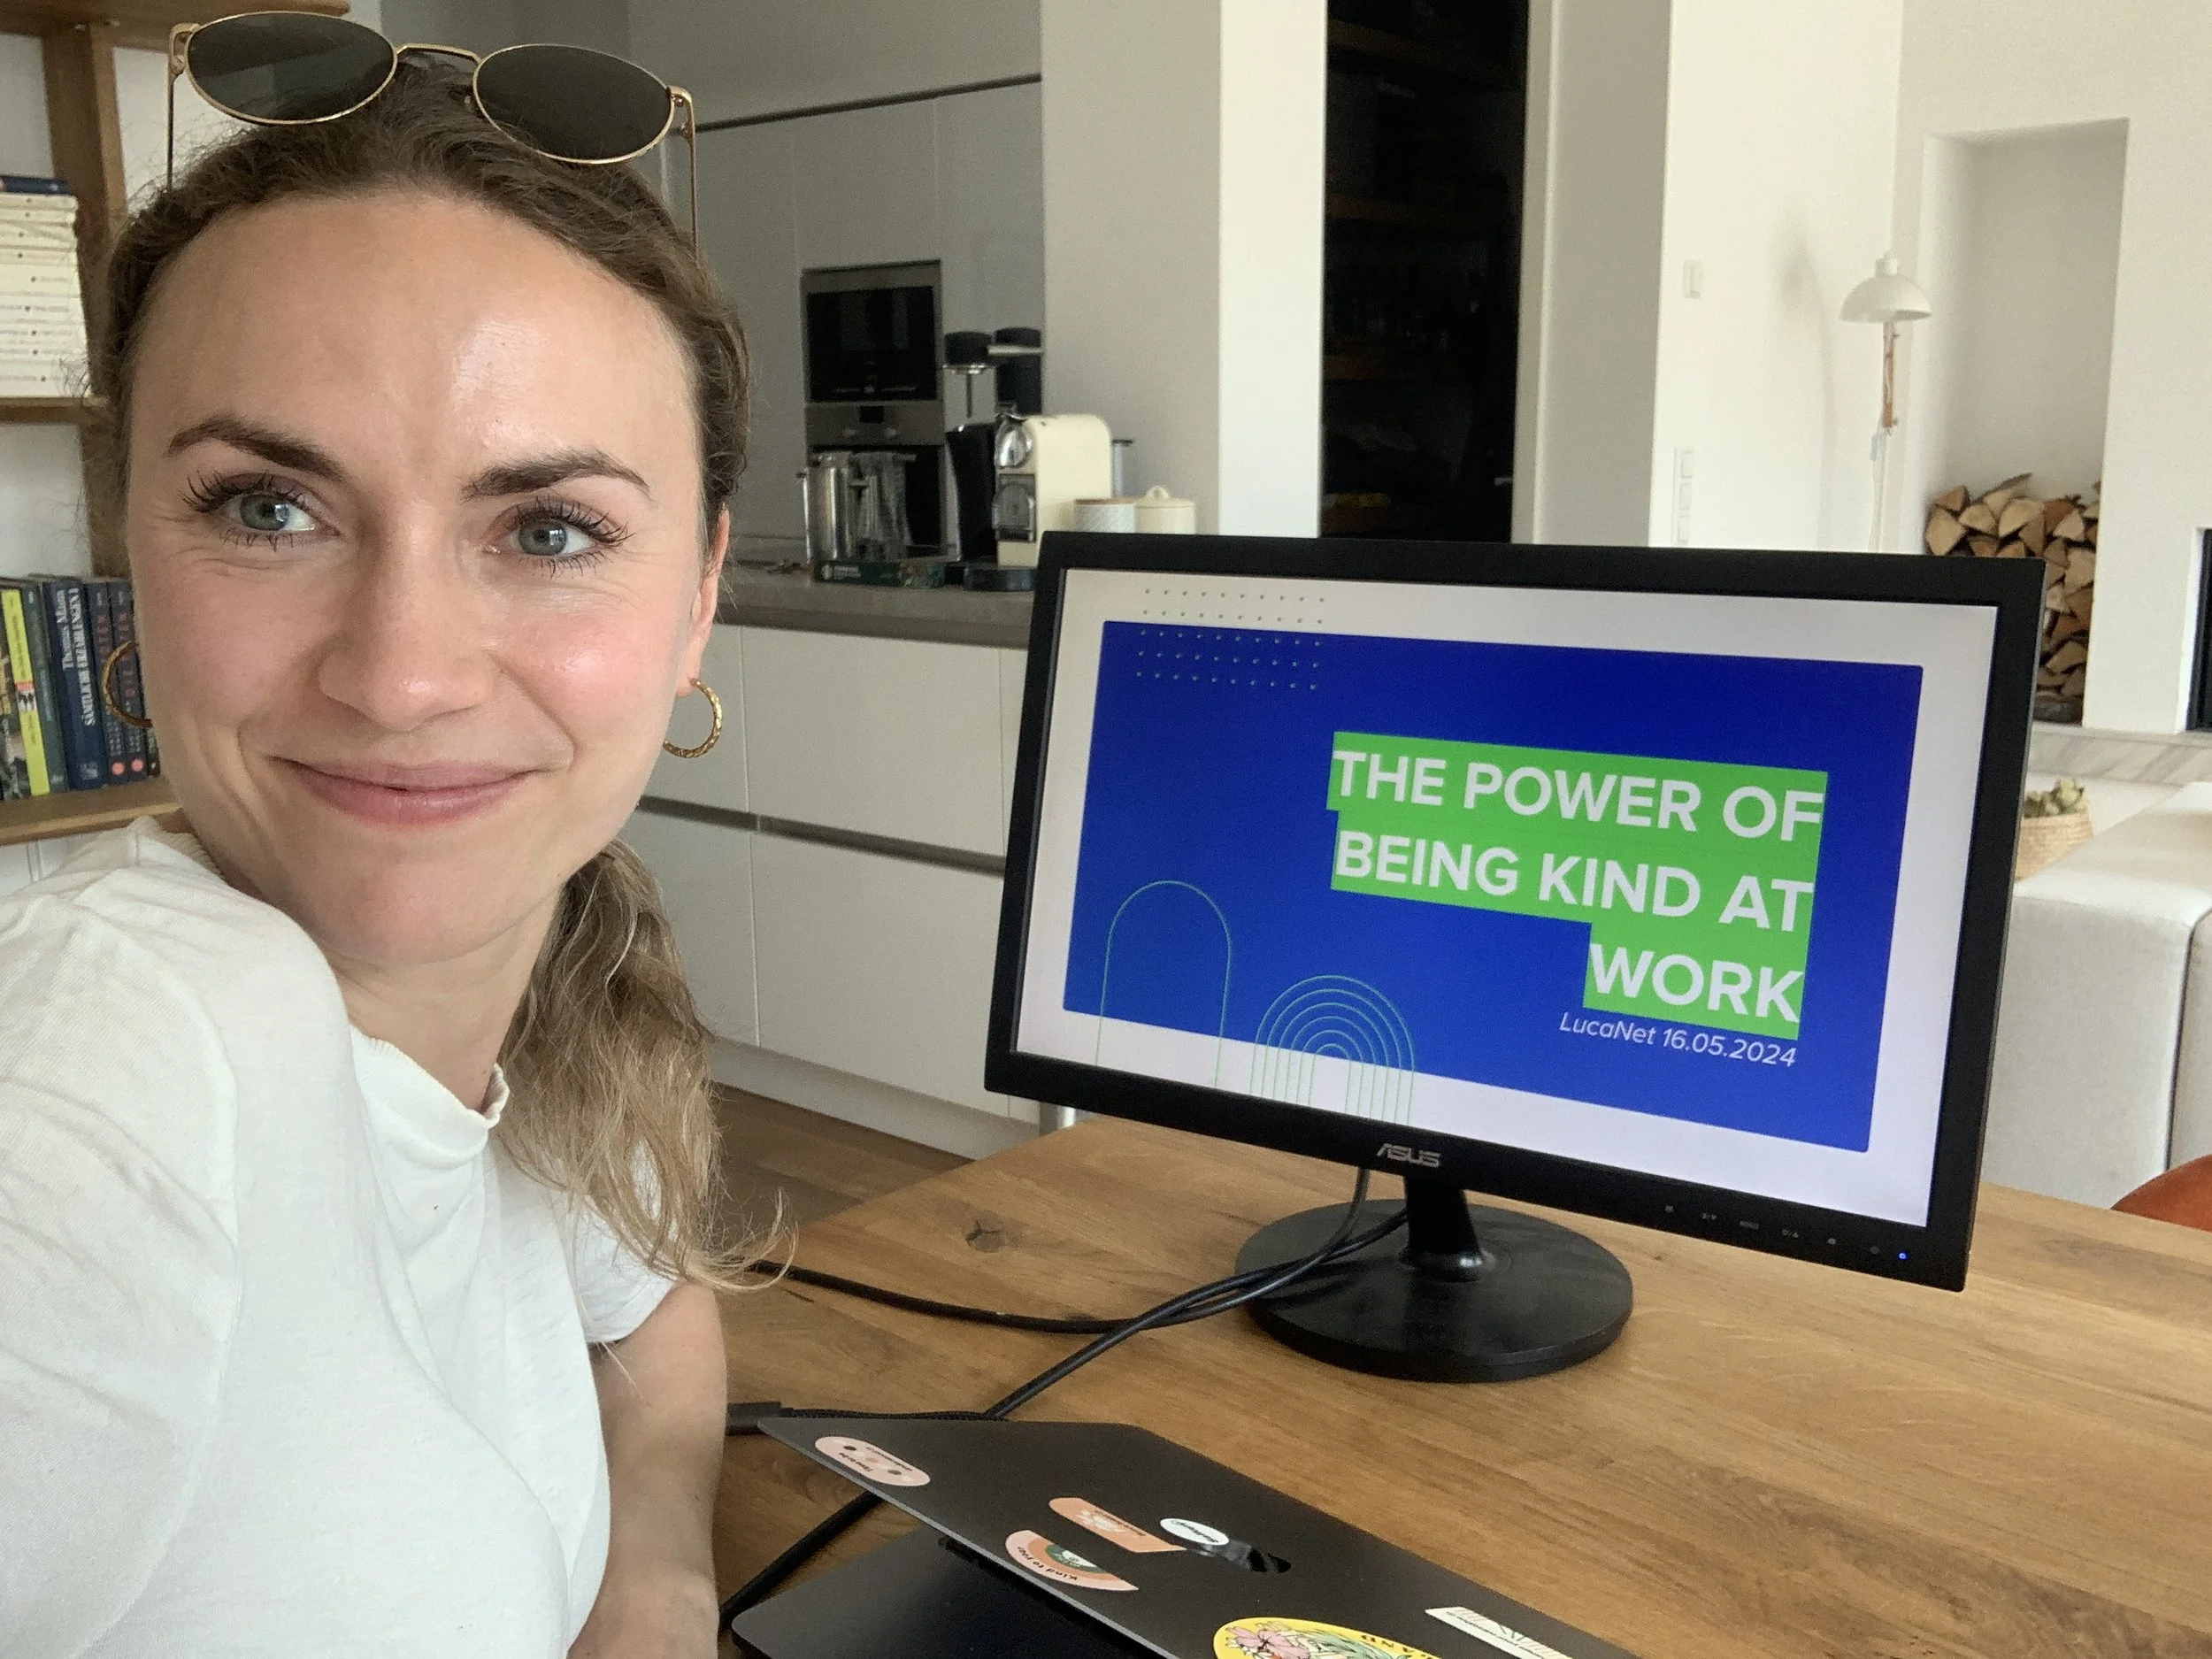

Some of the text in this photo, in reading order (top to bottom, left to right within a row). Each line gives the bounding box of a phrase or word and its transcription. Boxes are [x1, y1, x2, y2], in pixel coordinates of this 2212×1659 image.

[1332, 749, 1824, 841] THE POWER OF
[1335, 831, 1815, 933] BEING KIND AT
[1589, 943, 1805, 1024] WORK
[1559, 1011, 1797, 1067] LucaNet 16.05.2024
[1376, 1143, 1441, 1168] ASUS
